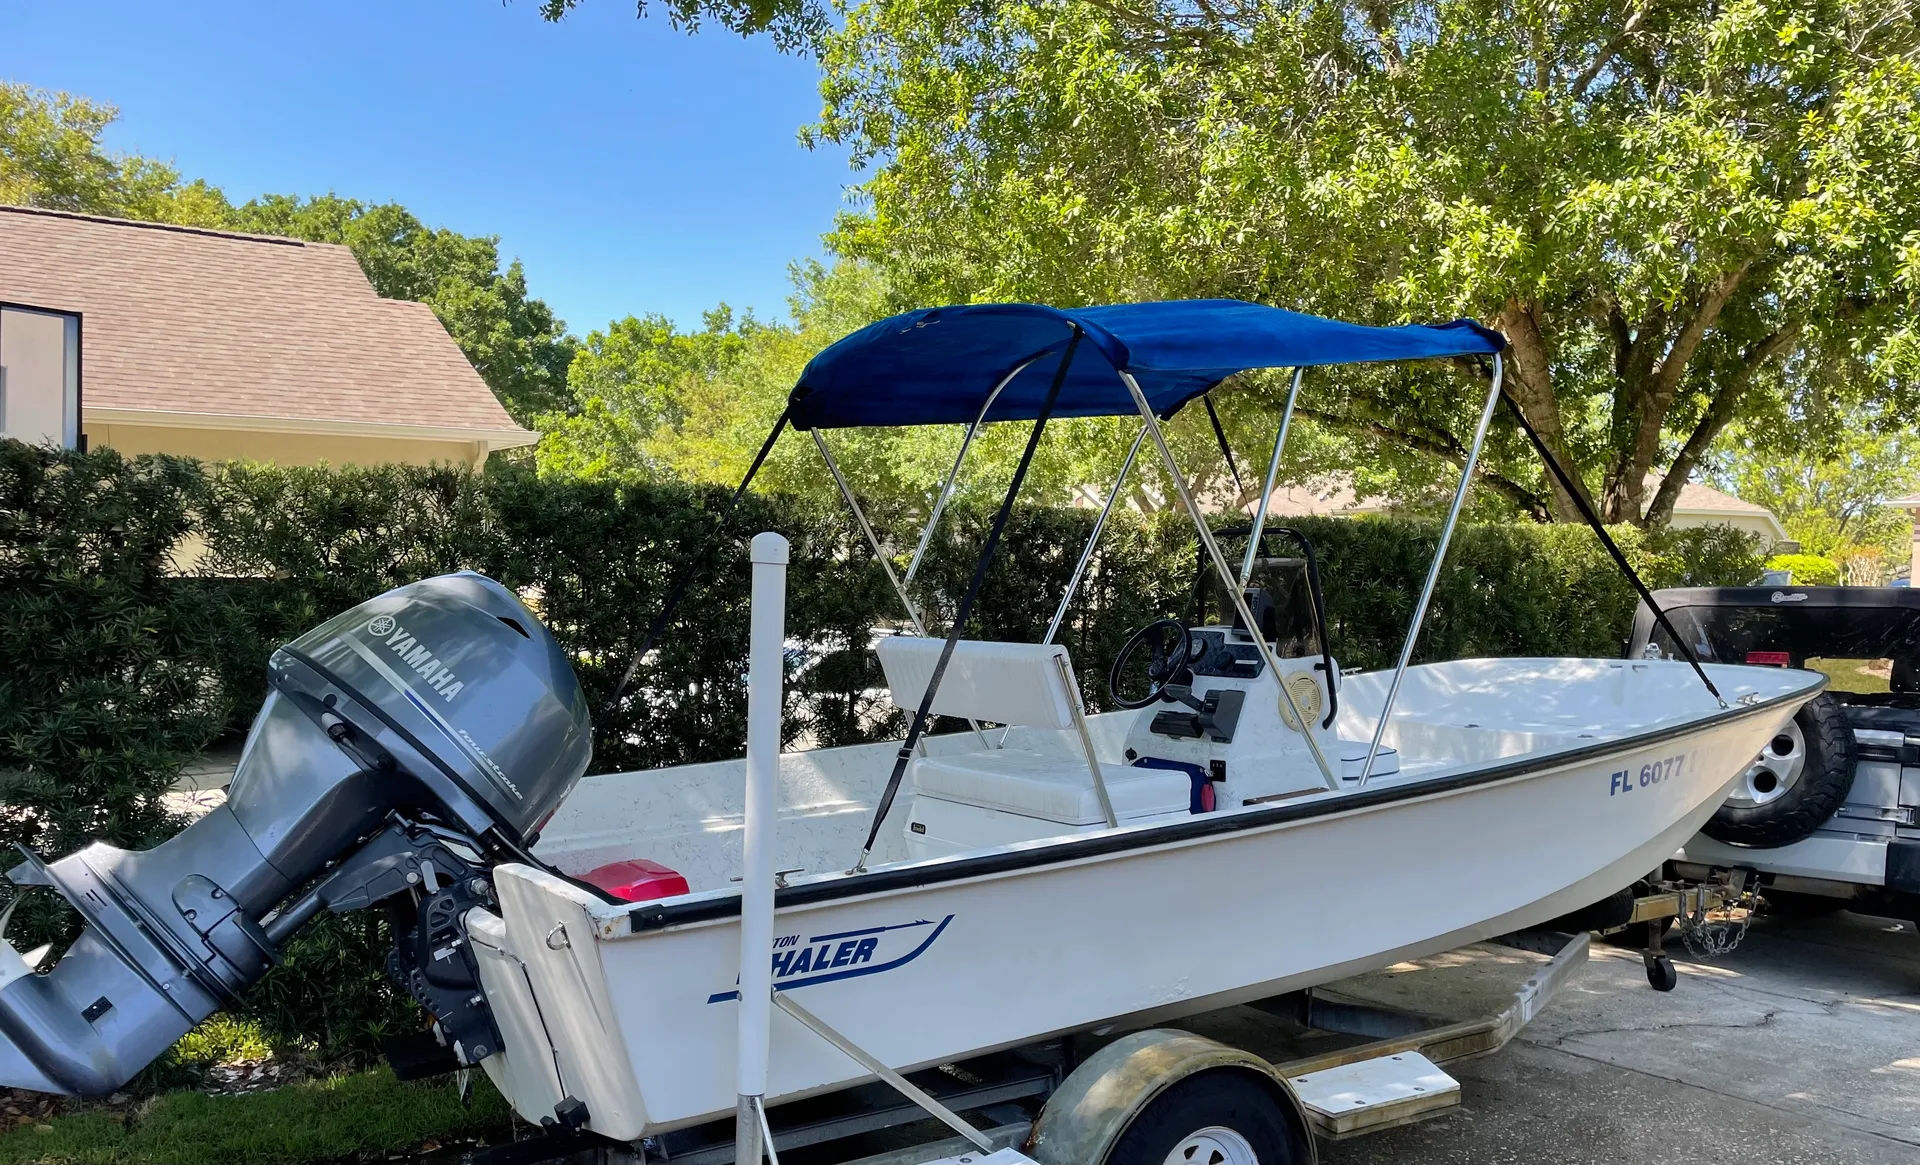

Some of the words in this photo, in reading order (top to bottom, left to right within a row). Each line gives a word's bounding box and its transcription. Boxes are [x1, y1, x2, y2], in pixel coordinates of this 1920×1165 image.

[385, 627, 464, 703] YAMAHA
[1610, 770, 1633, 796] FL
[1640, 755, 1685, 787] 6077
[736, 938, 878, 985] HALER
[773, 935, 800, 949] TON
